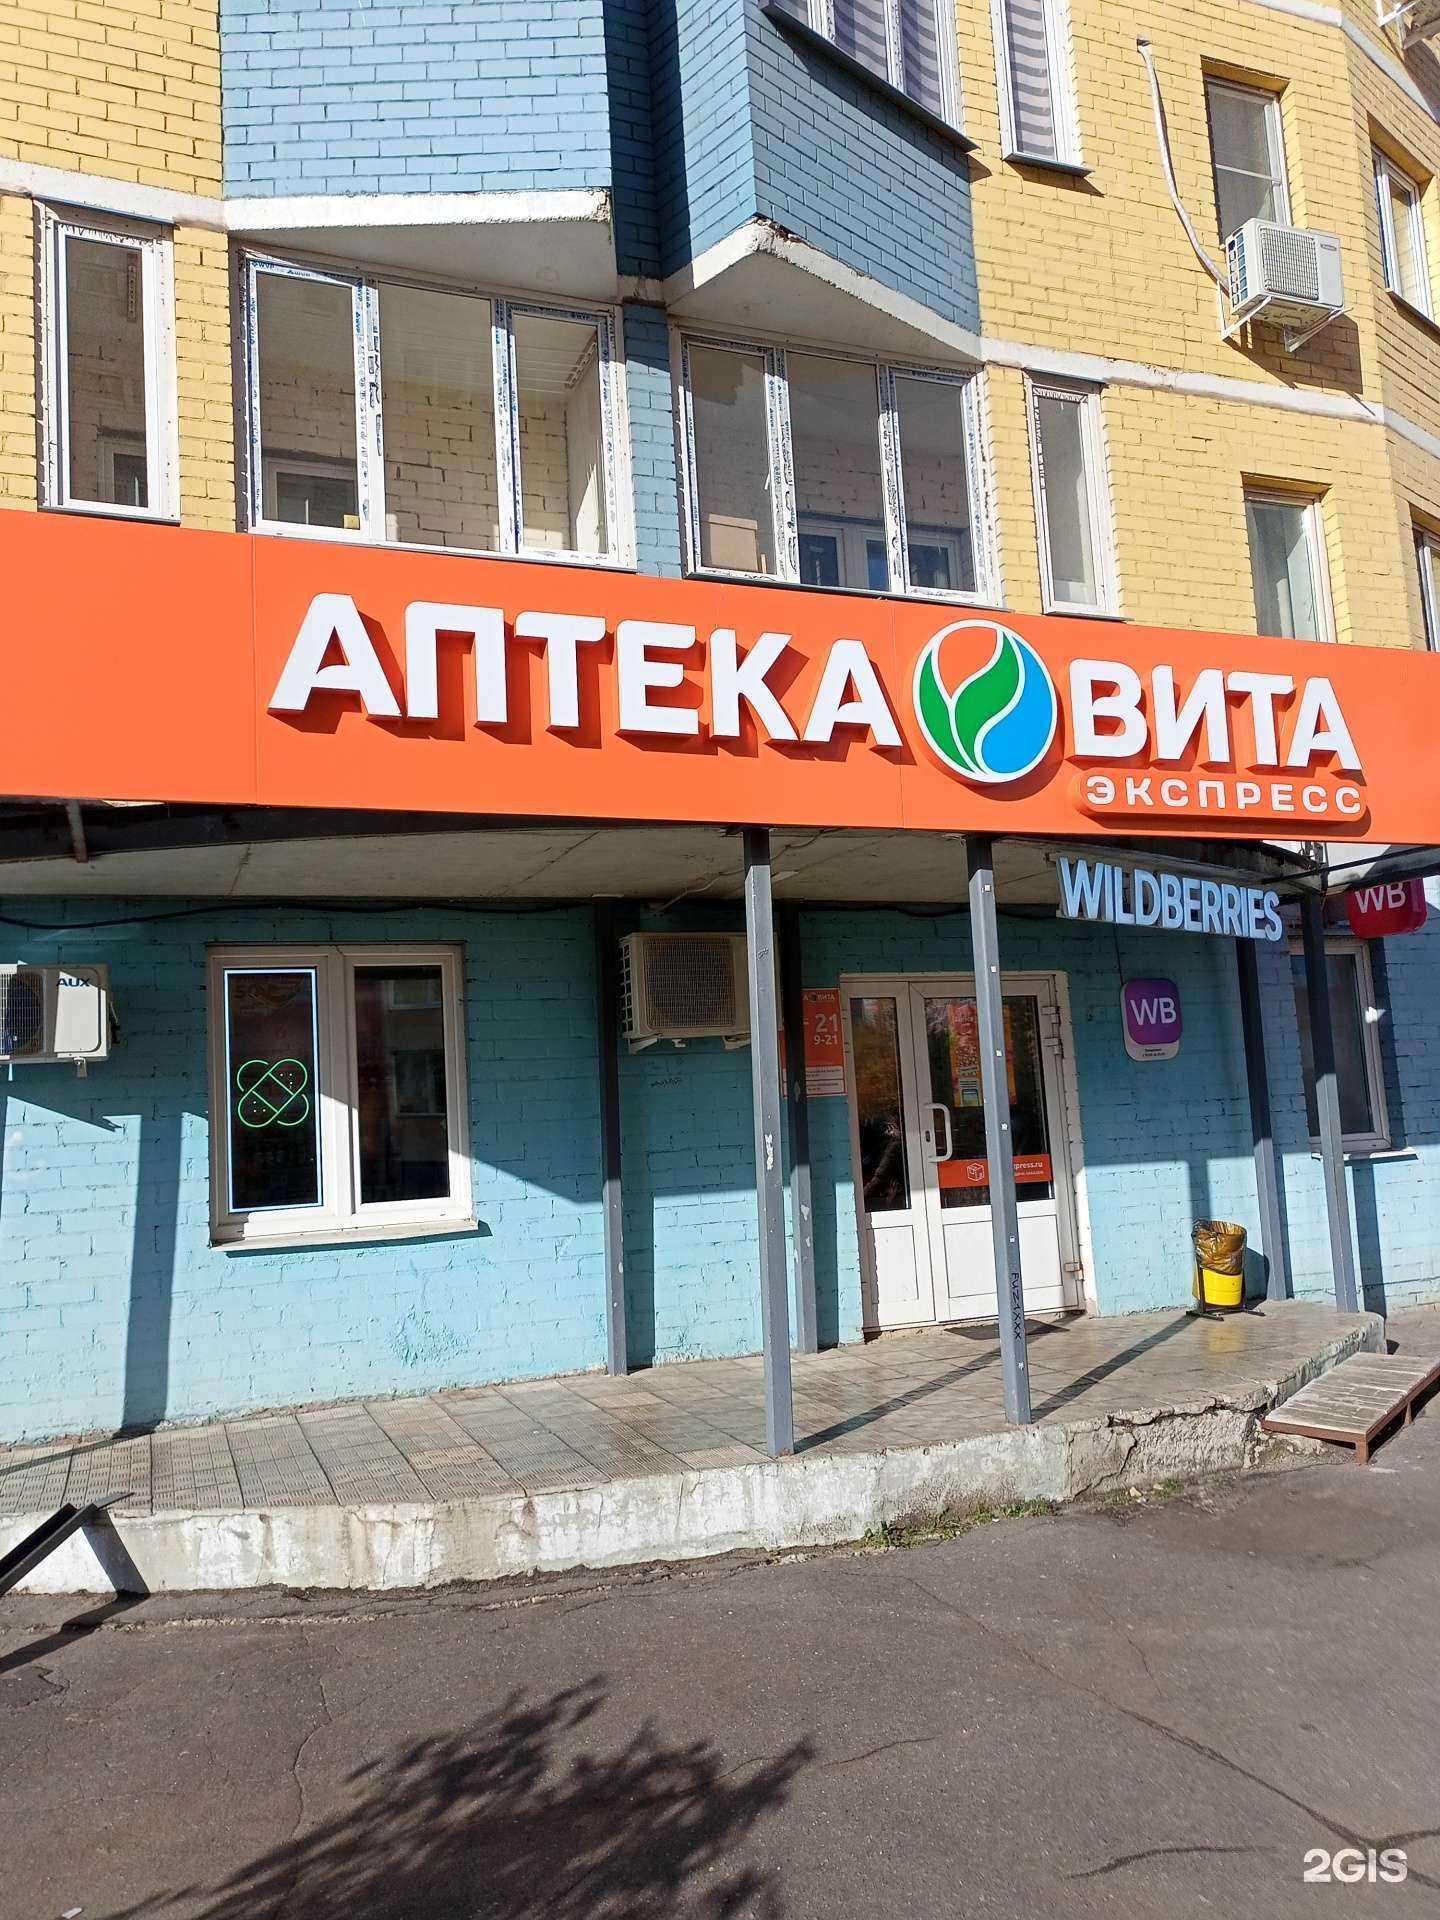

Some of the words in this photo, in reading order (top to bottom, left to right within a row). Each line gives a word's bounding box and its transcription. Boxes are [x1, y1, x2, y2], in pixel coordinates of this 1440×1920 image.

[267, 592, 904, 748] АПТЕКА
[1069, 658, 1362, 770] ВИТА
[1086, 776, 1361, 814] ЭКСПРЕСС
[1057, 857, 1284, 942] WILDBERRIES
[1354, 882, 1406, 914] WB
[56, 978, 90, 987] AUX
[1129, 997, 1177, 1026] WB
[813, 1034, 839, 1046] 9-21
[1013, 1162, 1043, 1171] press.ru
